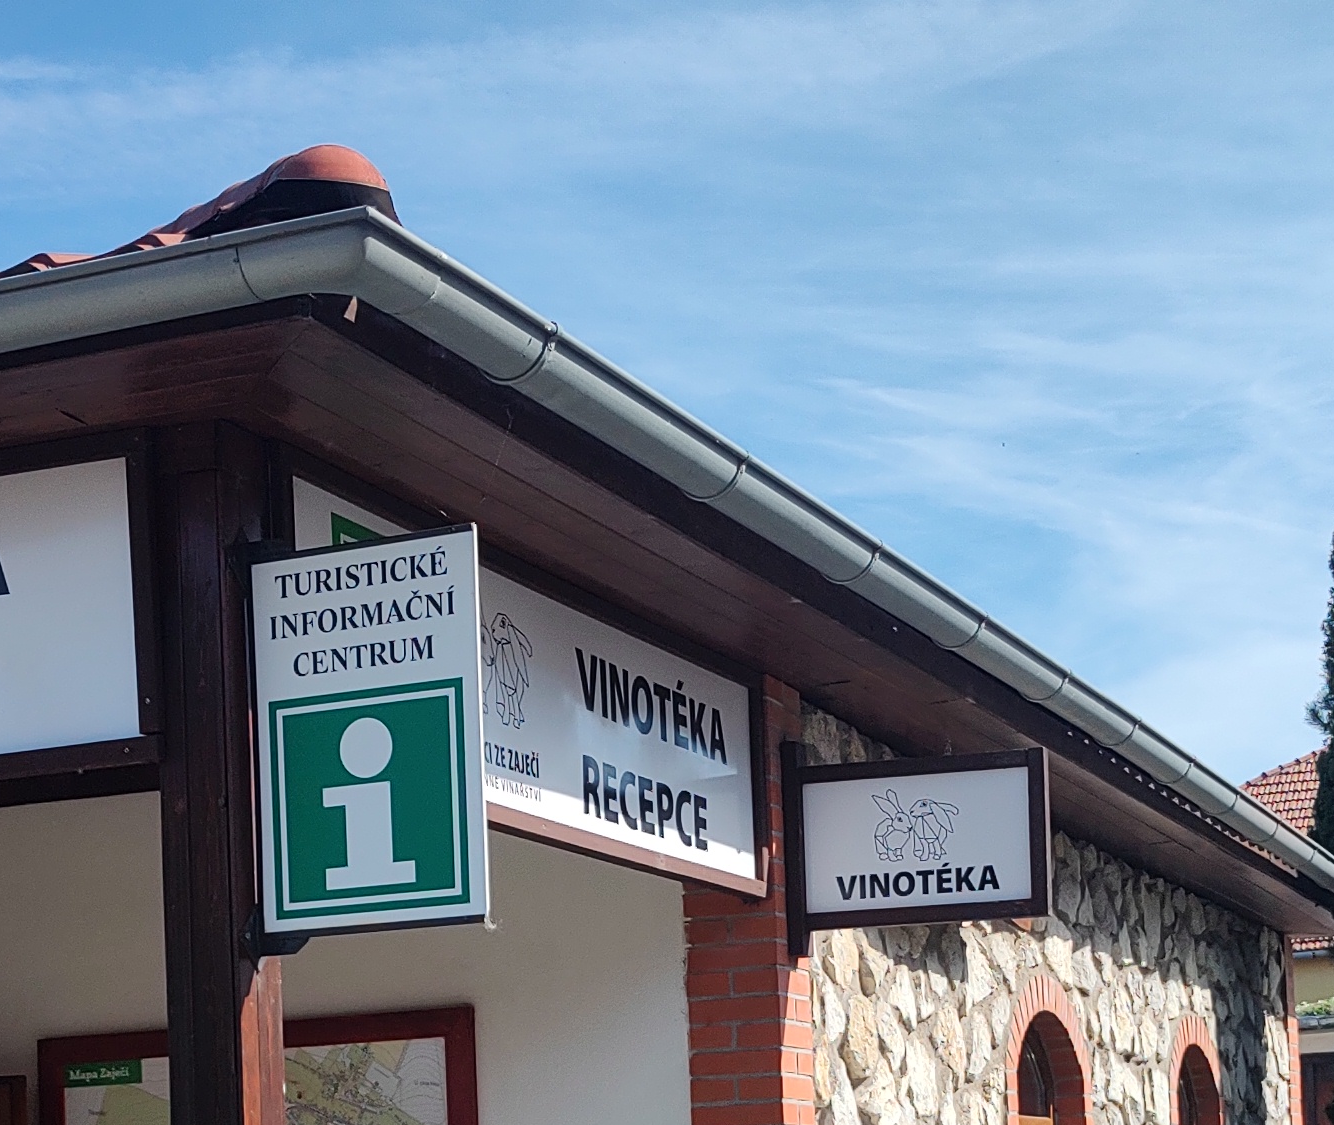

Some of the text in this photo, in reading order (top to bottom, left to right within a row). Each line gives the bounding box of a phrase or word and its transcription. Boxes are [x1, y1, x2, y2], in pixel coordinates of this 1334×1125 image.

[274, 545, 448, 598] TURISTICKÉ
[270, 585, 455, 640] INFORMAČNÍ
[293, 634, 434, 677] CENTRUM
[574, 646, 728, 766] VINOTÉKA
[494, 743, 506, 768] ZE
[507, 748, 540, 779] ZAJEČÍ
[582, 754, 709, 852] RECEPCE
[836, 862, 1000, 901] VINOTÉKA
[69, 1070, 98, 1083] Mapa
